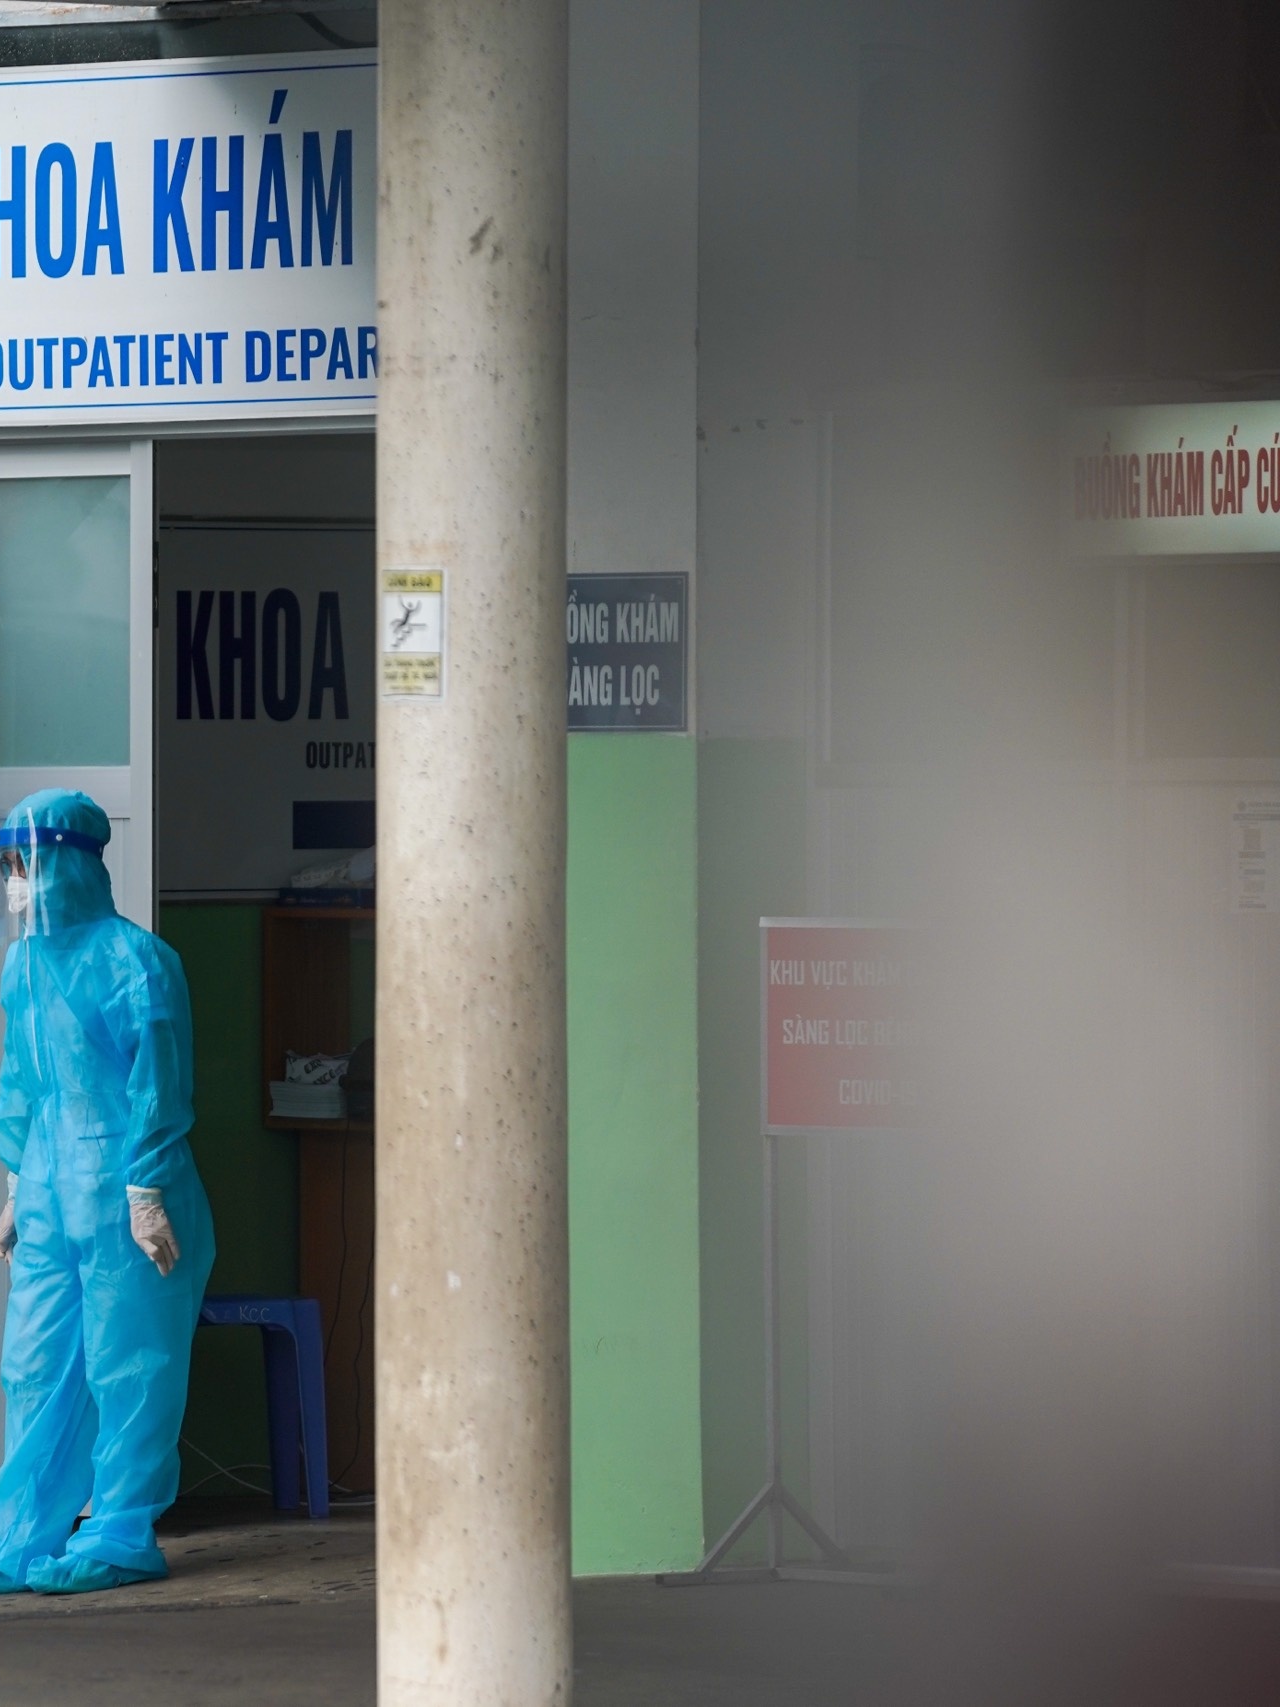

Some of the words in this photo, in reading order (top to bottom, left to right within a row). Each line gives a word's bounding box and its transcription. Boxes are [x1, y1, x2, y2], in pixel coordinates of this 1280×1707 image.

[152, 89, 354, 274] KHÁM
[245, 326, 379, 384] DEPAR
[1147, 437, 1205, 518] KHÁM
[1211, 424, 1251, 516] CẤP
[616, 593, 679, 643] KHÁM
[176, 587, 350, 722] KHOA
[620, 664, 660, 715] LỌC
[770, 960, 805, 986] KHU
[811, 960, 848, 990] VỰC
[783, 1014, 829, 1045] SÀNG
[836, 1019, 869, 1050] LỌC
